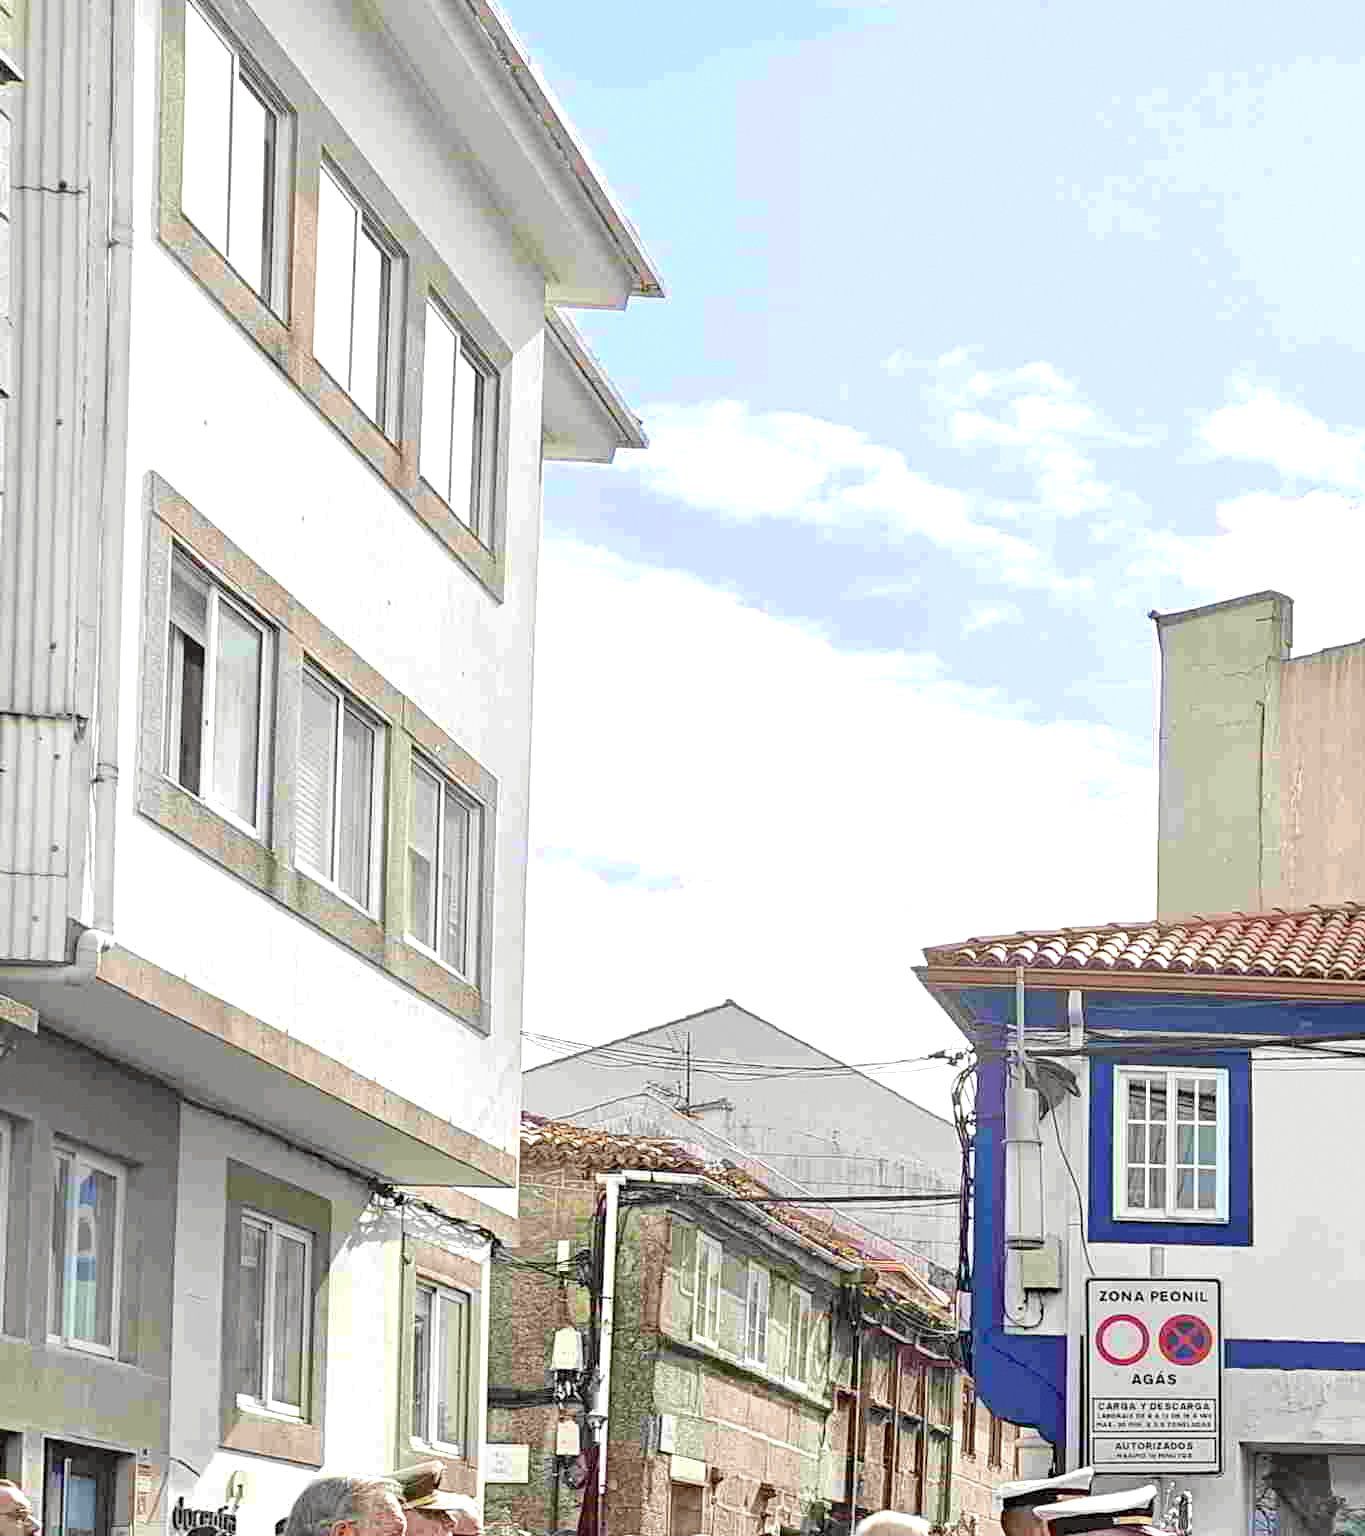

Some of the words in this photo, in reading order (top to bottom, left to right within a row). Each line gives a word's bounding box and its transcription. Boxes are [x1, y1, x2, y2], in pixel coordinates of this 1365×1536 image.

[1099, 1290, 1145, 1302] ZONA
[1150, 1290, 1208, 1302] PEONIL
[1131, 1371, 1177, 1385] AGÁS
[1098, 1402, 1137, 1410] CARGA
[1141, 1402, 1146, 1410] Y
[1150, 1402, 1211, 1410] DESCARGA
[1115, 1442, 1194, 1450] AUTORIZADOS
